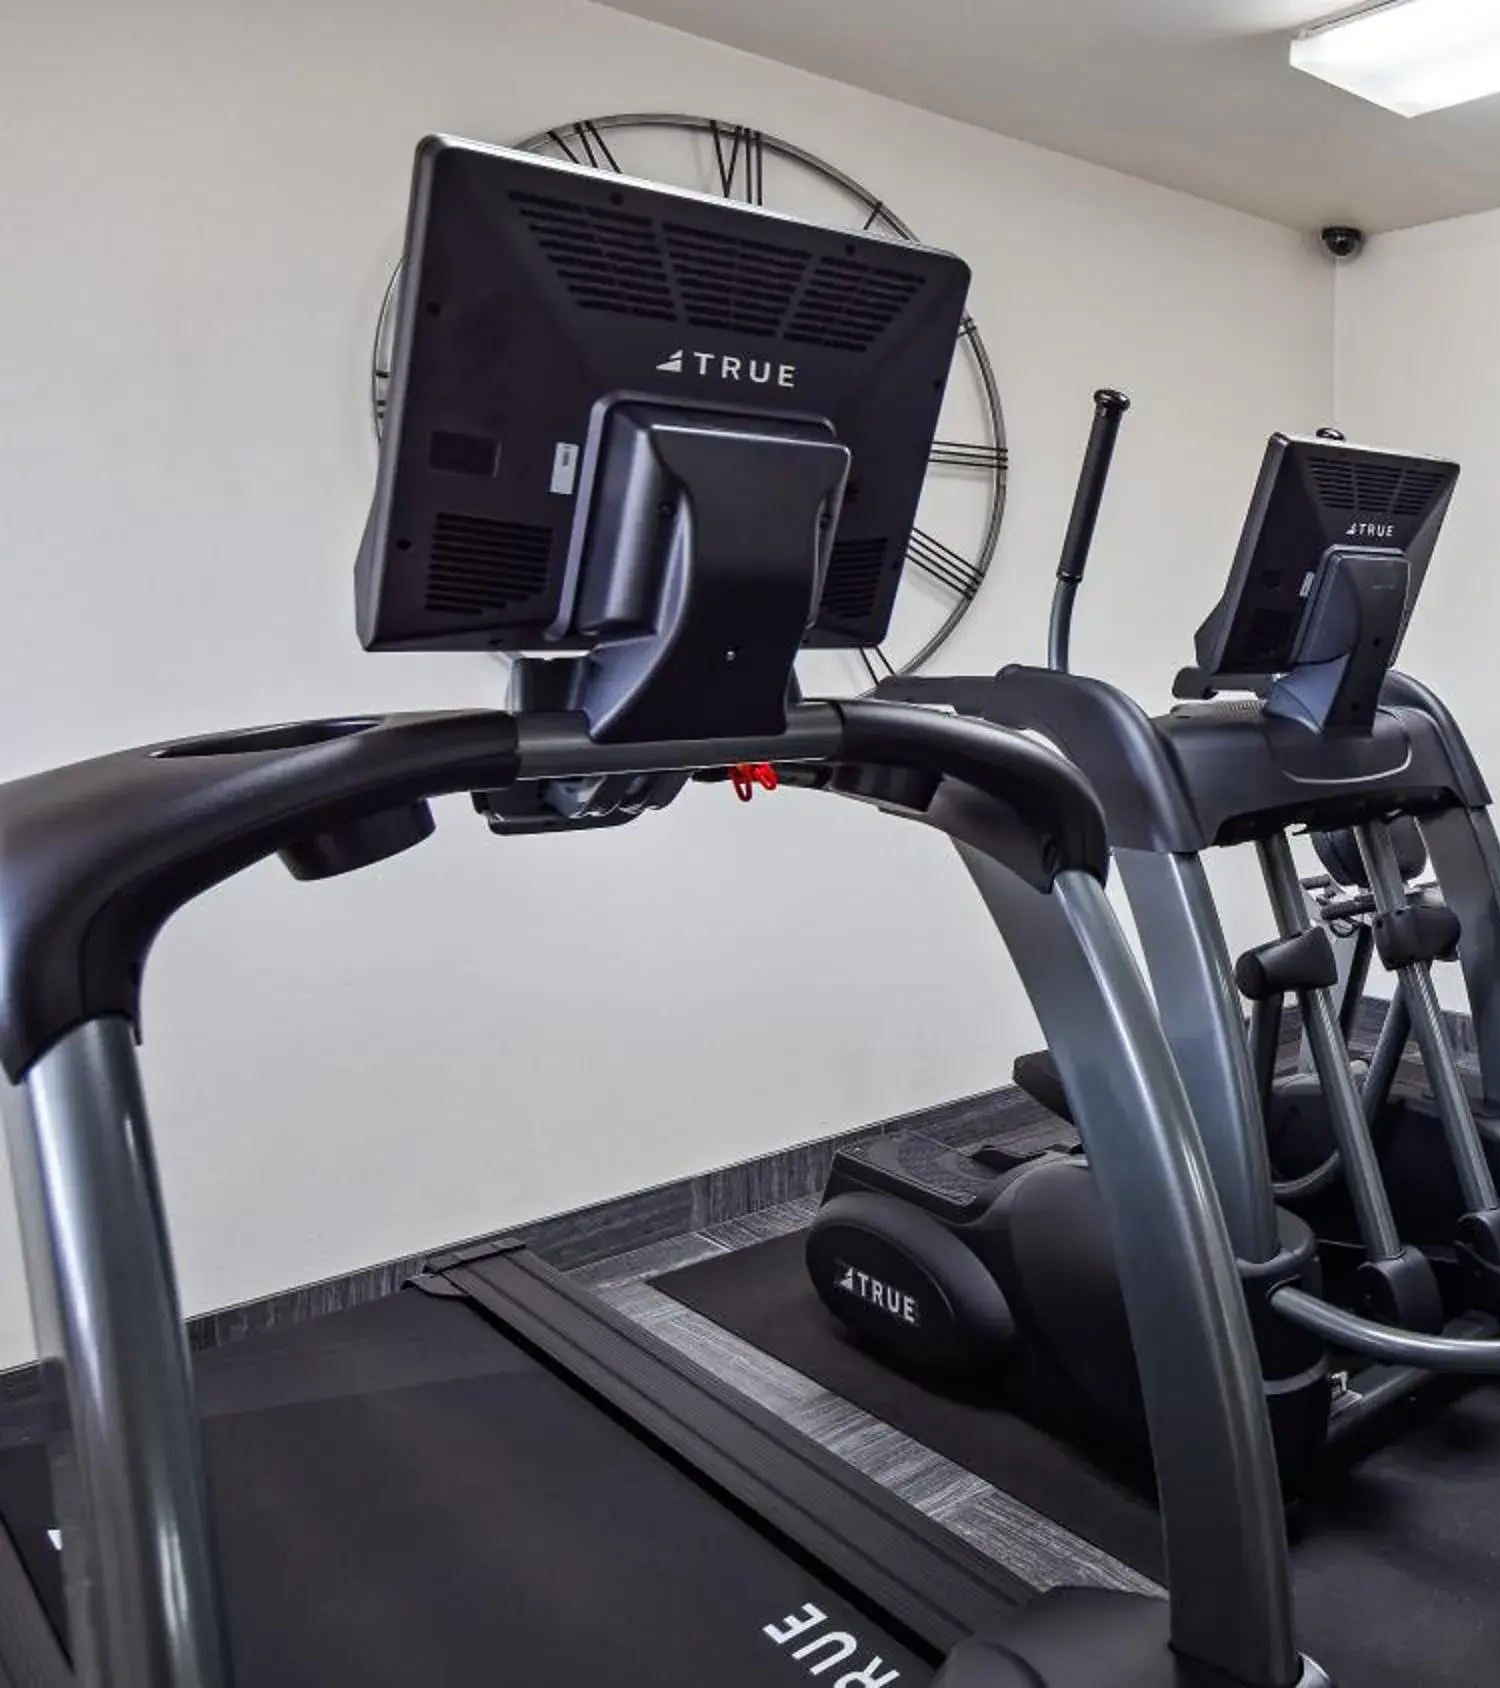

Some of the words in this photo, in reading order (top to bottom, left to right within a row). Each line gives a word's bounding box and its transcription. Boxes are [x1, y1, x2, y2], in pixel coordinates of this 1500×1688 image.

[693, 351, 796, 388] TRUE
[1359, 523, 1394, 537] TRUE
[857, 1271, 915, 1324] TRUE
